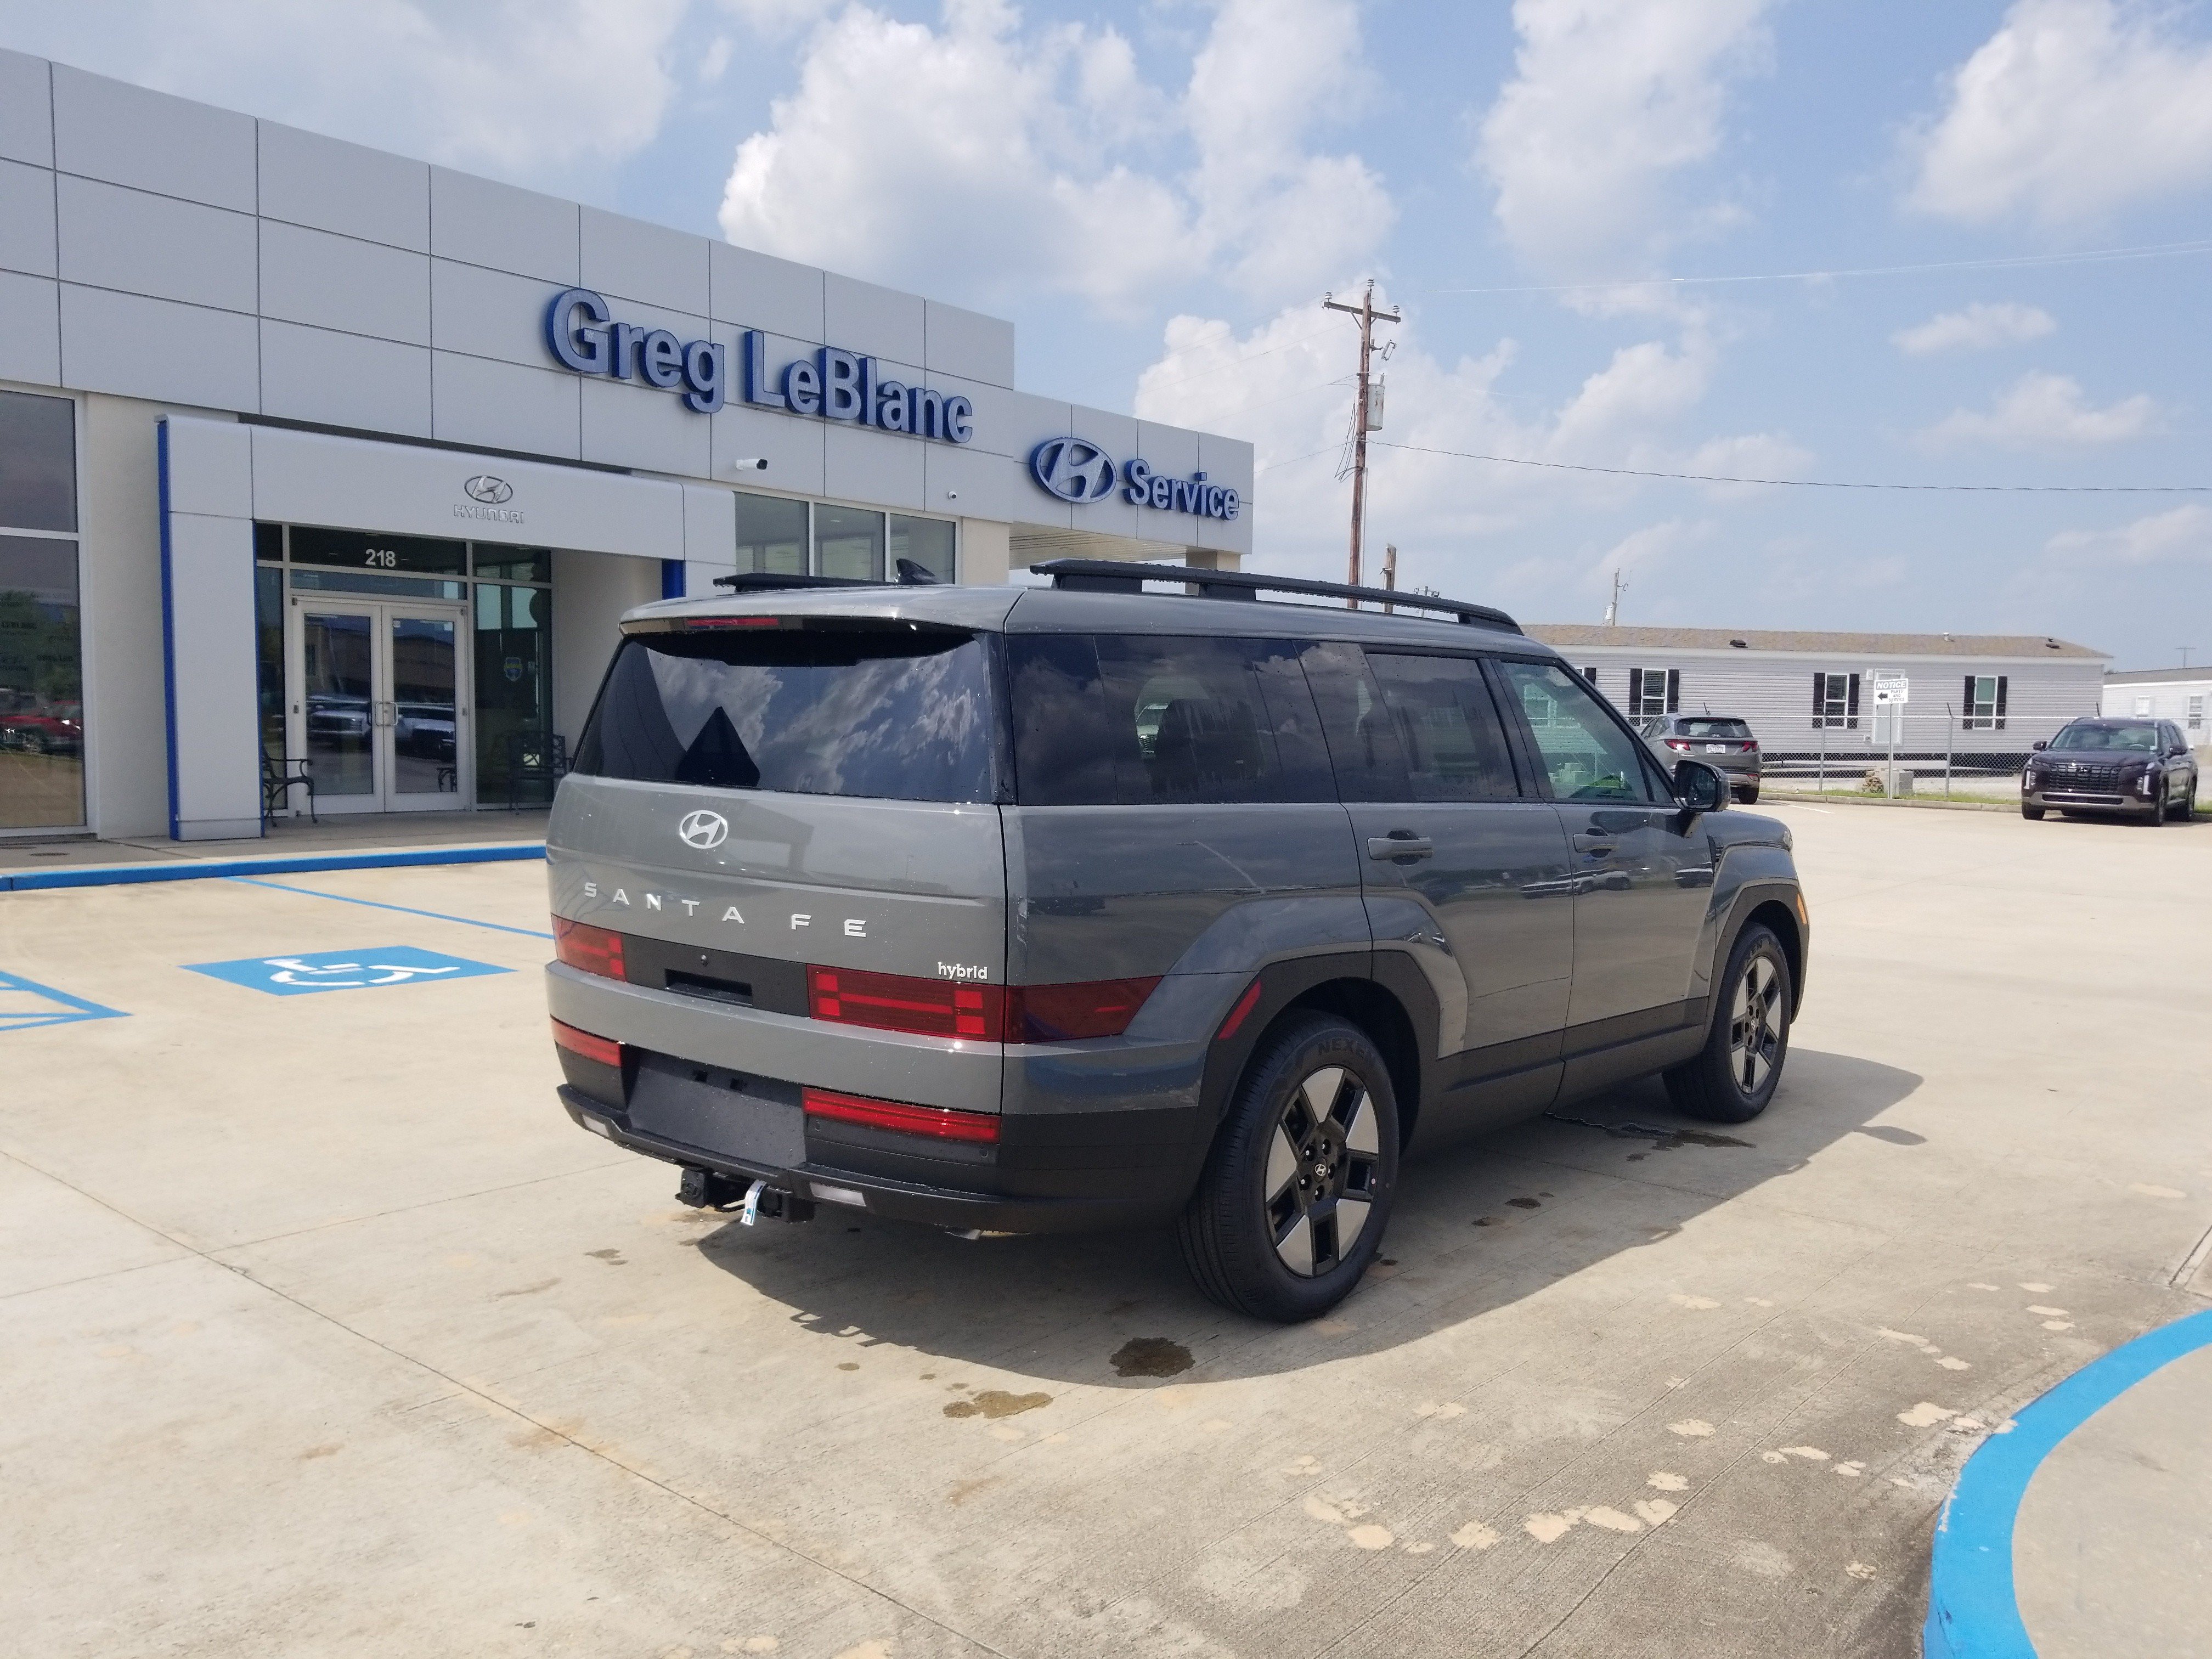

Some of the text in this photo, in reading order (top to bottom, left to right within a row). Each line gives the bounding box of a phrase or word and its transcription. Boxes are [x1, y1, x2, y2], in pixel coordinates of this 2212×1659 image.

[546, 288, 973, 444] Greg LeBlanc
[1122, 459, 1240, 521] Service
[454, 504, 524, 524] HYUNDAI
[365, 549, 396, 567] 218
[1877, 681, 1906, 689] NOTICE
[584, 882, 867, 938] SANTA FE
[938, 962, 988, 979] hybrid
